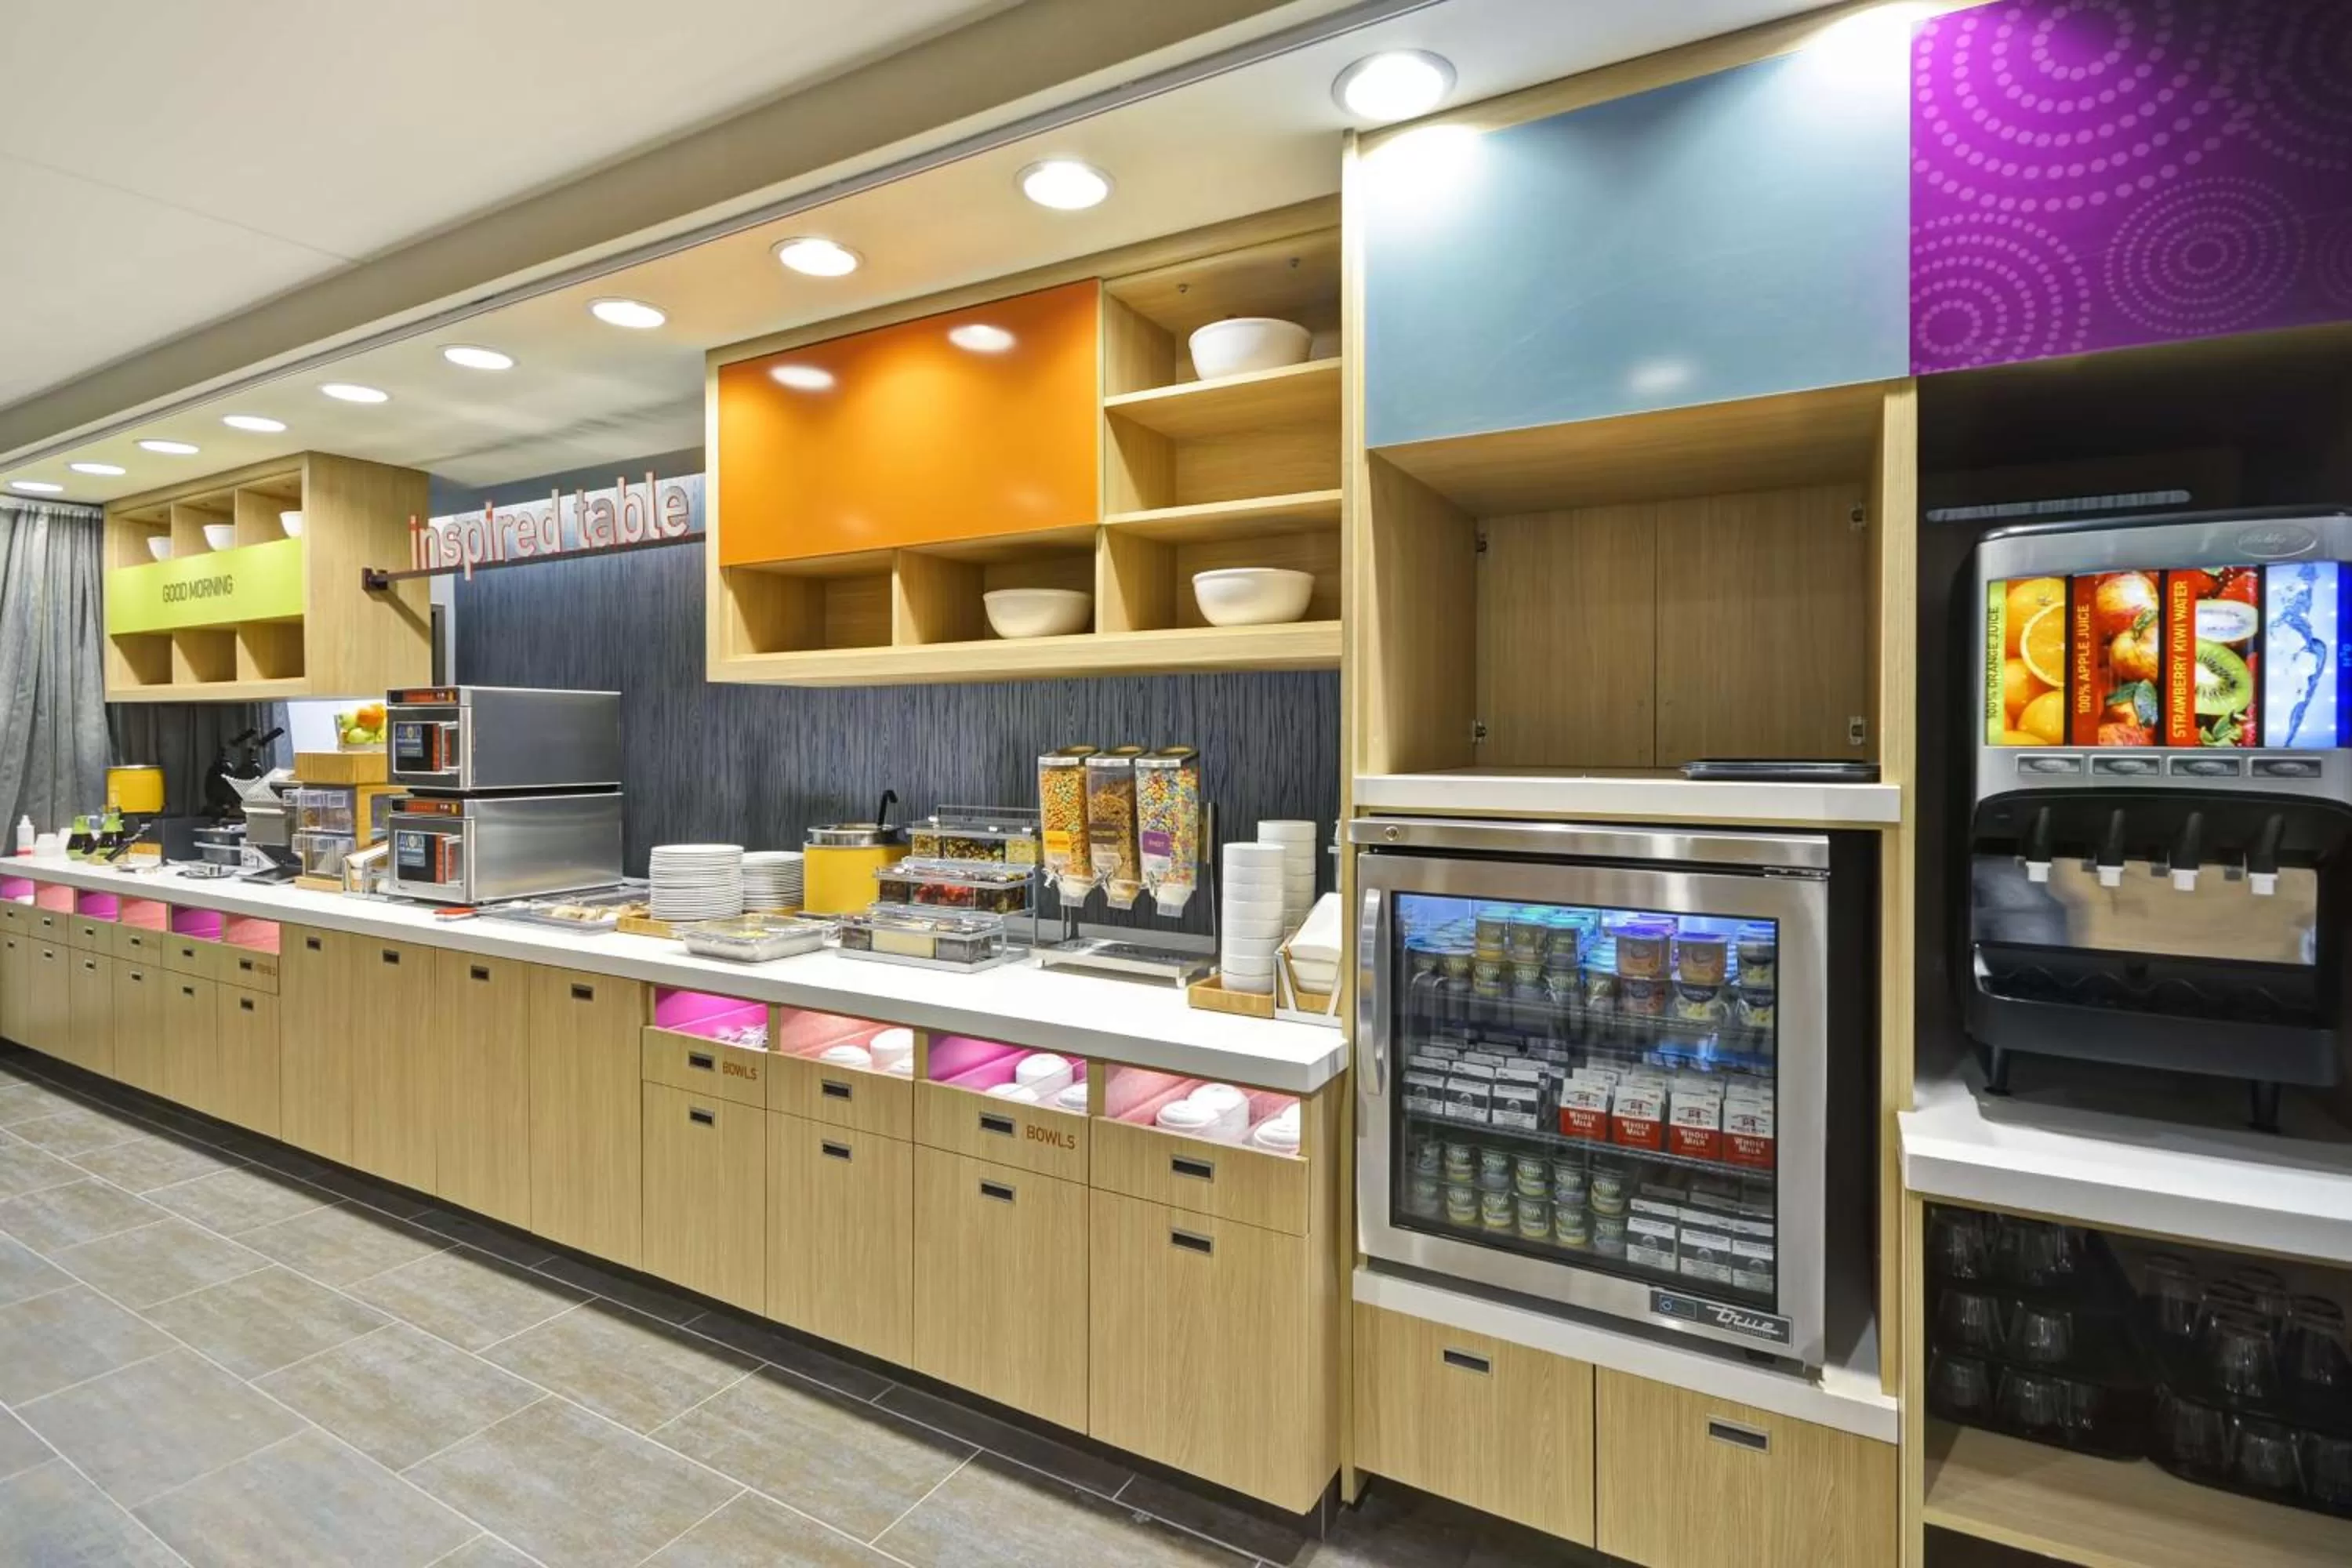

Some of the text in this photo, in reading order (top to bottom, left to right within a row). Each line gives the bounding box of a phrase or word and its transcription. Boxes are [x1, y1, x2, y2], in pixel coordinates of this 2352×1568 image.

[410, 470, 690, 582] inspired table
[162, 574, 233, 603] GOOD MORNING
[1987, 606, 2000, 641] JUICE
[1986, 642, 1999, 689] ORANGE
[2077, 604, 2091, 714] 100% APPLE JUICE
[2172, 580, 2188, 739] STRAWBERRY KIWI WATER
[722, 1061, 757, 1081] BOWLS
[1026, 1124, 1076, 1150] BOWLS
